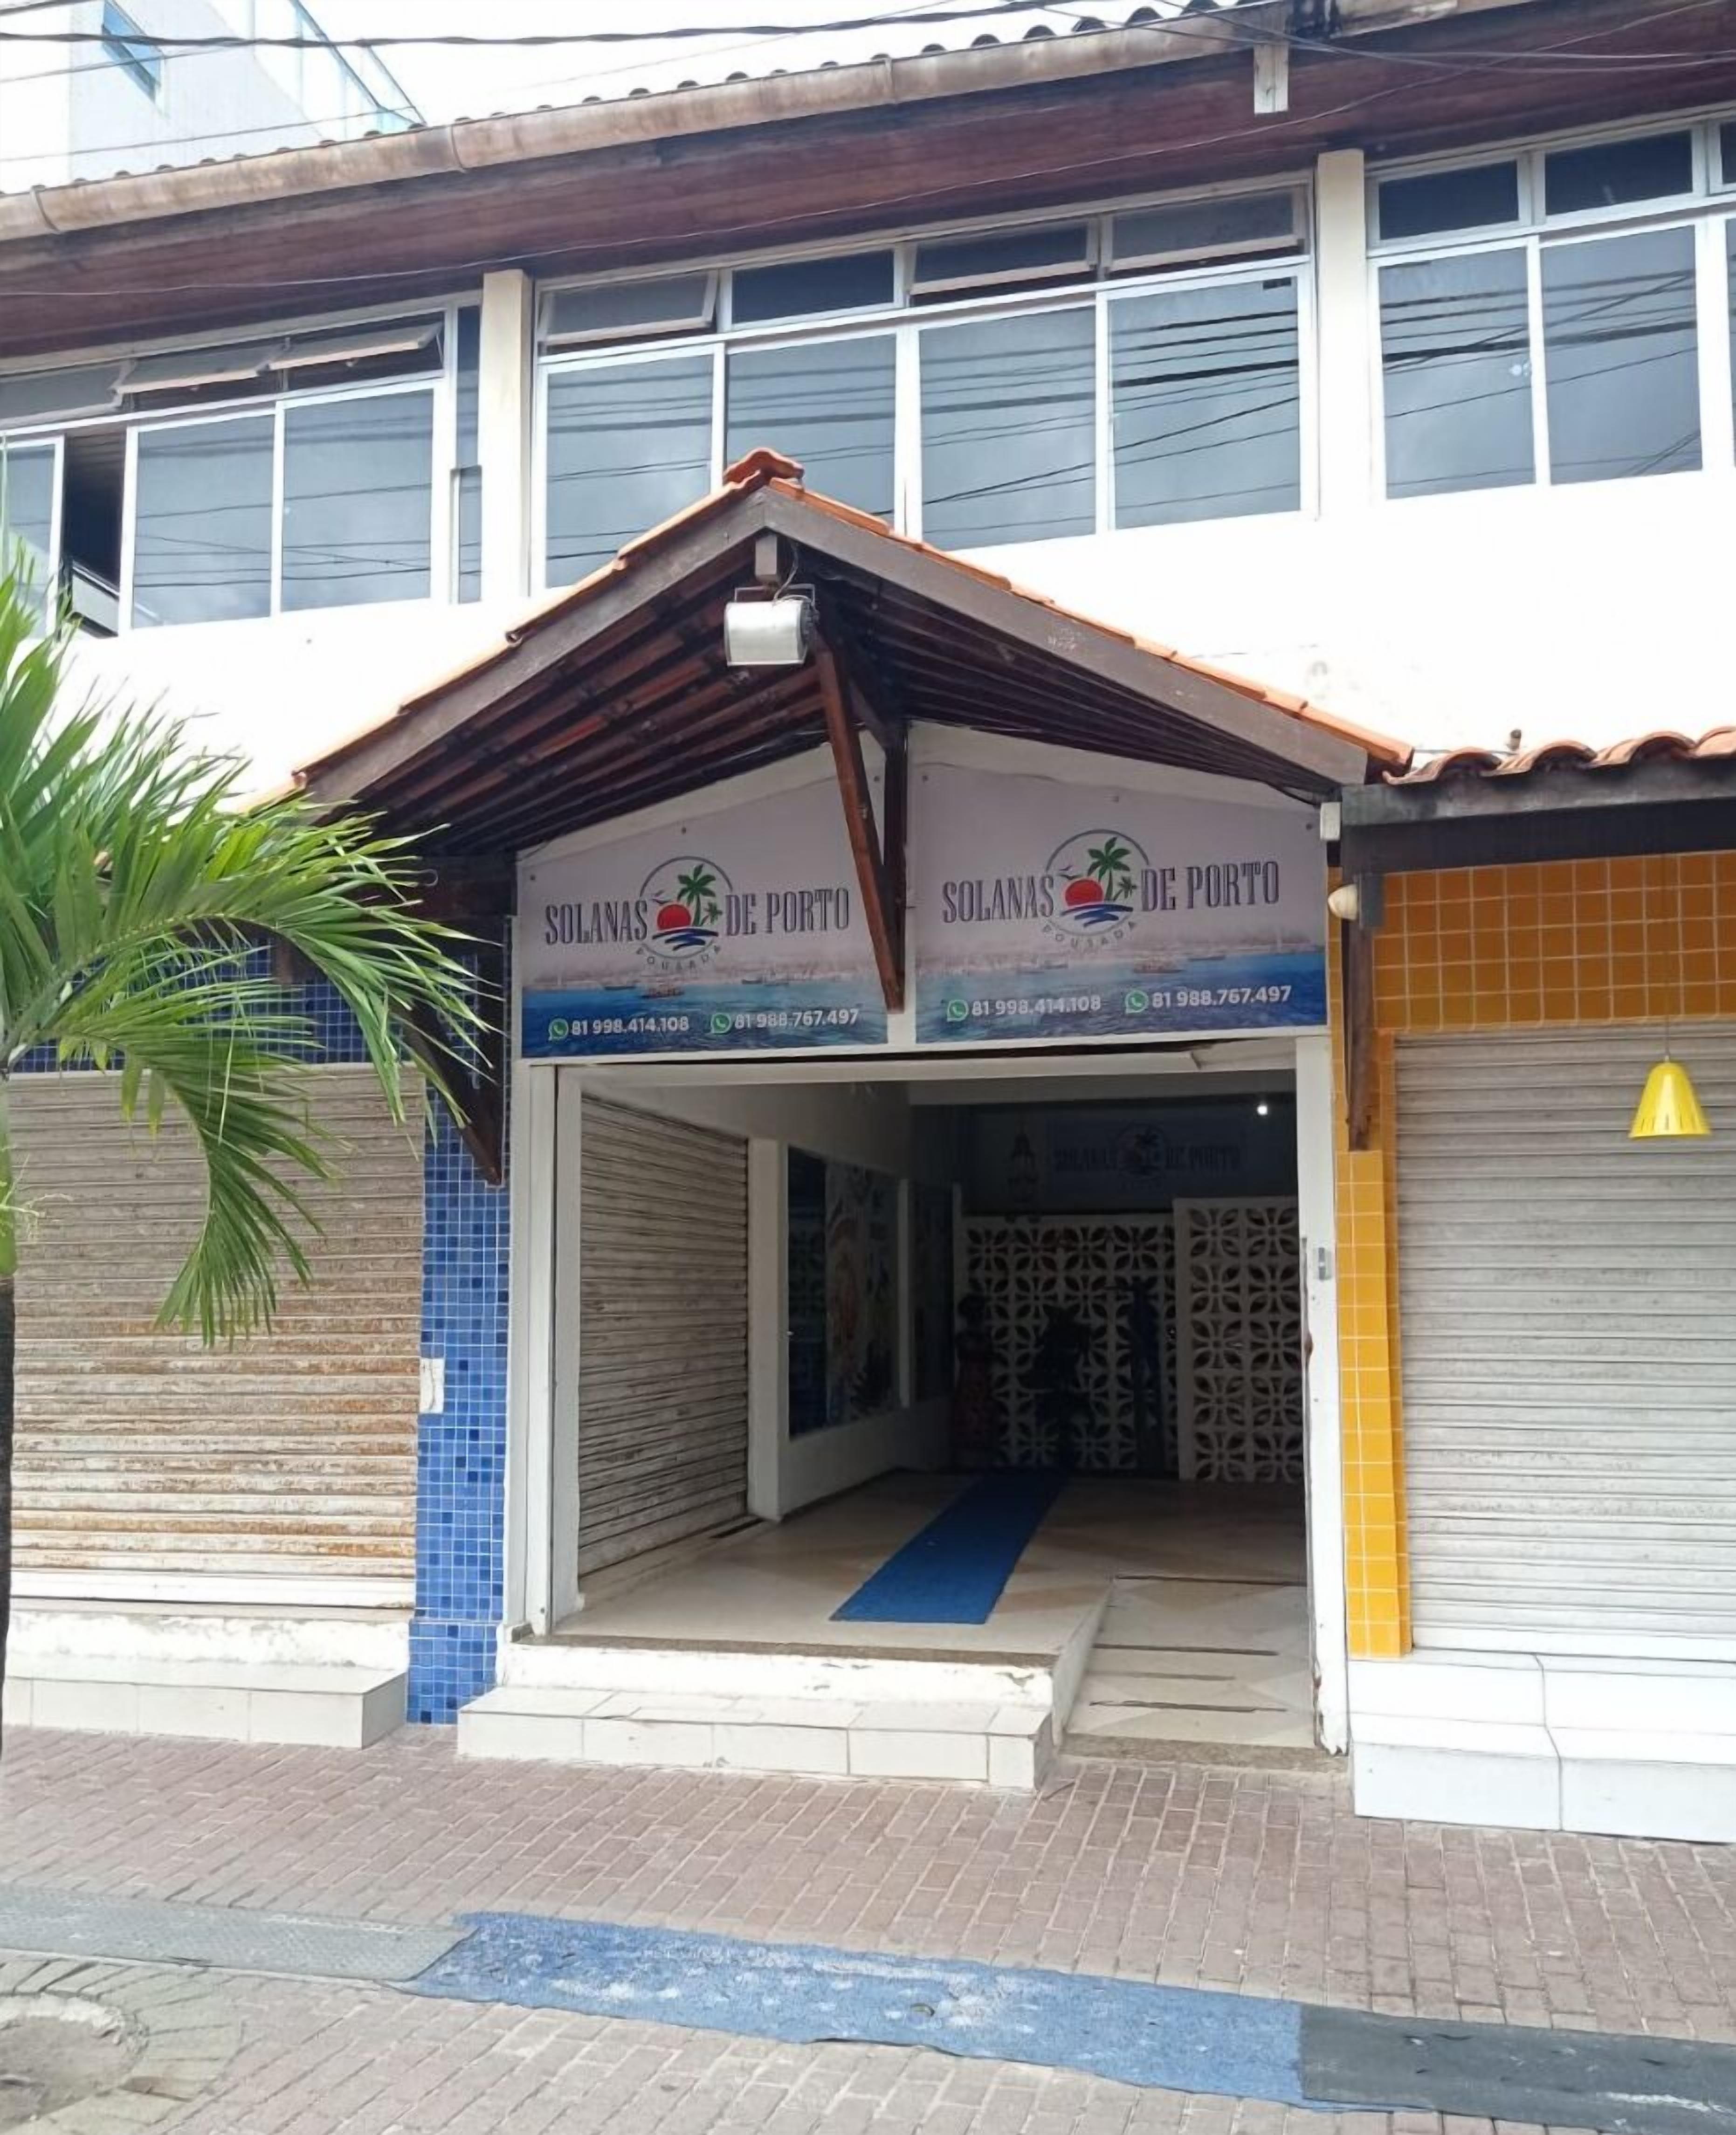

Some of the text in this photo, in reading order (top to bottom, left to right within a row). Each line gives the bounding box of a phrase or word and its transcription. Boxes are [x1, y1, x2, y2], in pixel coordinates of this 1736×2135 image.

[943, 861, 1279, 923] SOLANAS DE PORTO
[545, 888, 849, 945] SOLANAS DE PORTO
[971, 995, 1102, 1016] 81 998.414.108
[1152, 985, 1292, 1008] 81 988.767.497
[572, 1016, 689, 1035] 81 998.414.108
[735, 1008, 860, 1029] 81 988.767.497
